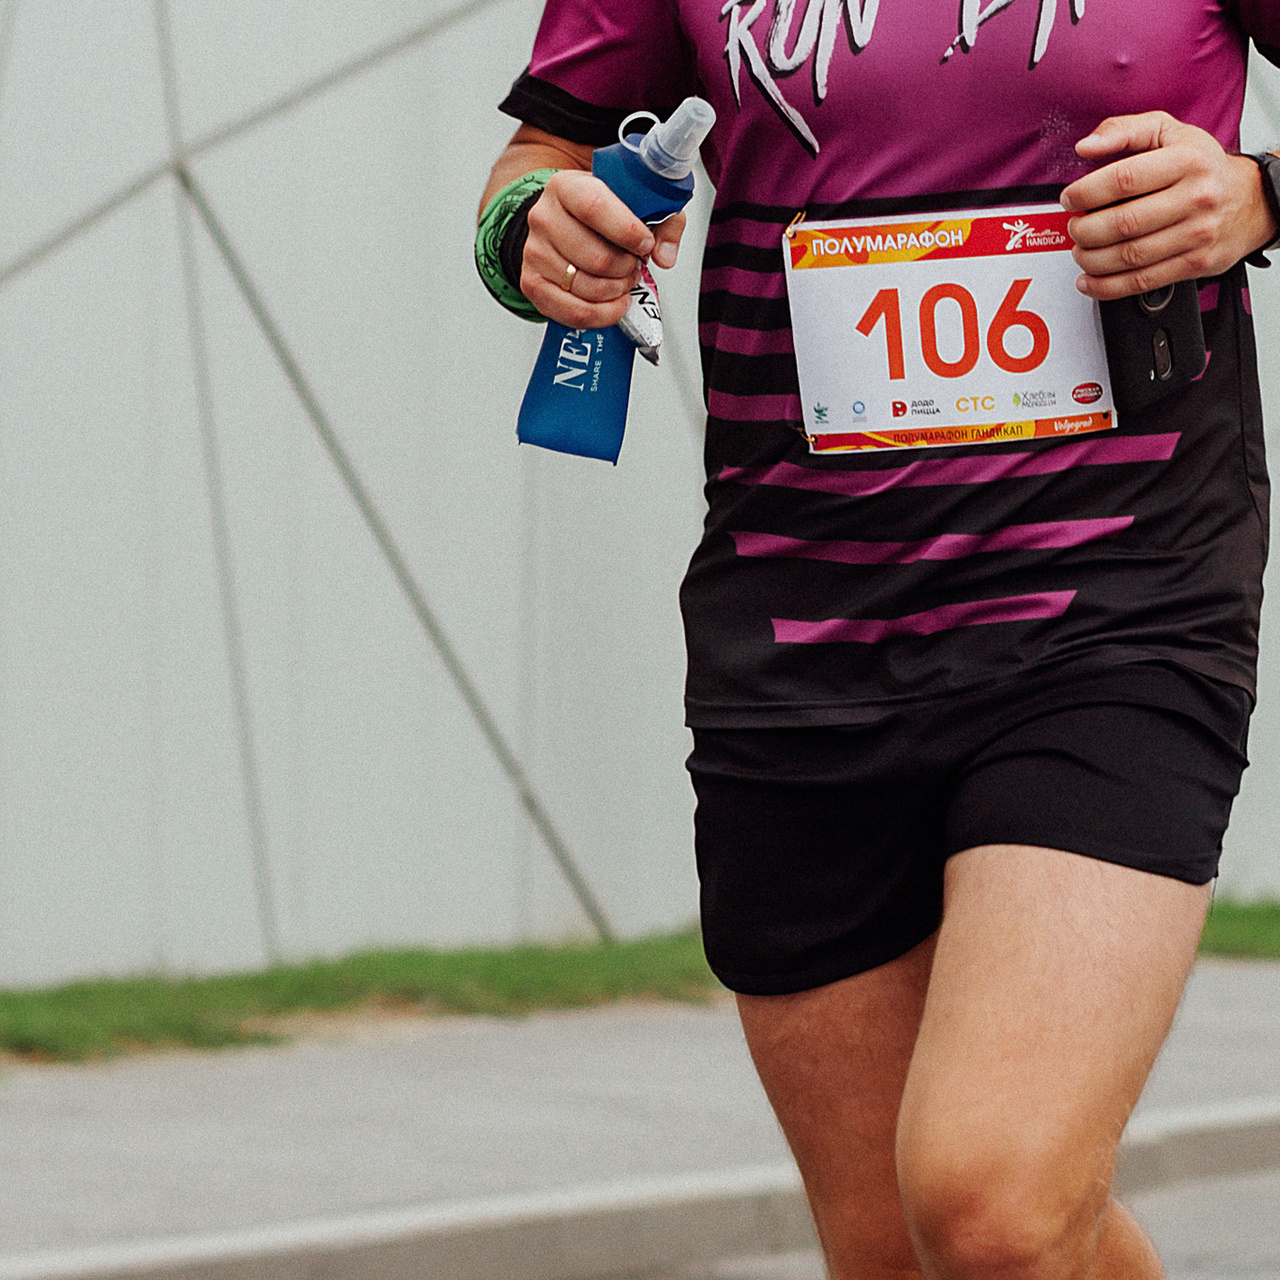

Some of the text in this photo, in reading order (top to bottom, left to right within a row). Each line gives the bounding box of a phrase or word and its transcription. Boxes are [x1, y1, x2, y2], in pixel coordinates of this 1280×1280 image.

[811, 228, 964, 257] ПОЛУМАРАФОН
[1026, 235, 1066, 247] HANDICAP
[855, 278, 1050, 380] 106
[590, 360, 602, 392] SHARE
[911, 399, 935, 408] ДОДО
[911, 407, 940, 416] ПИЦЦА
[955, 395, 995, 412] СТС
[893, 425, 1023, 444] ПОЛУМАРАФОН ГАНДИКАП
